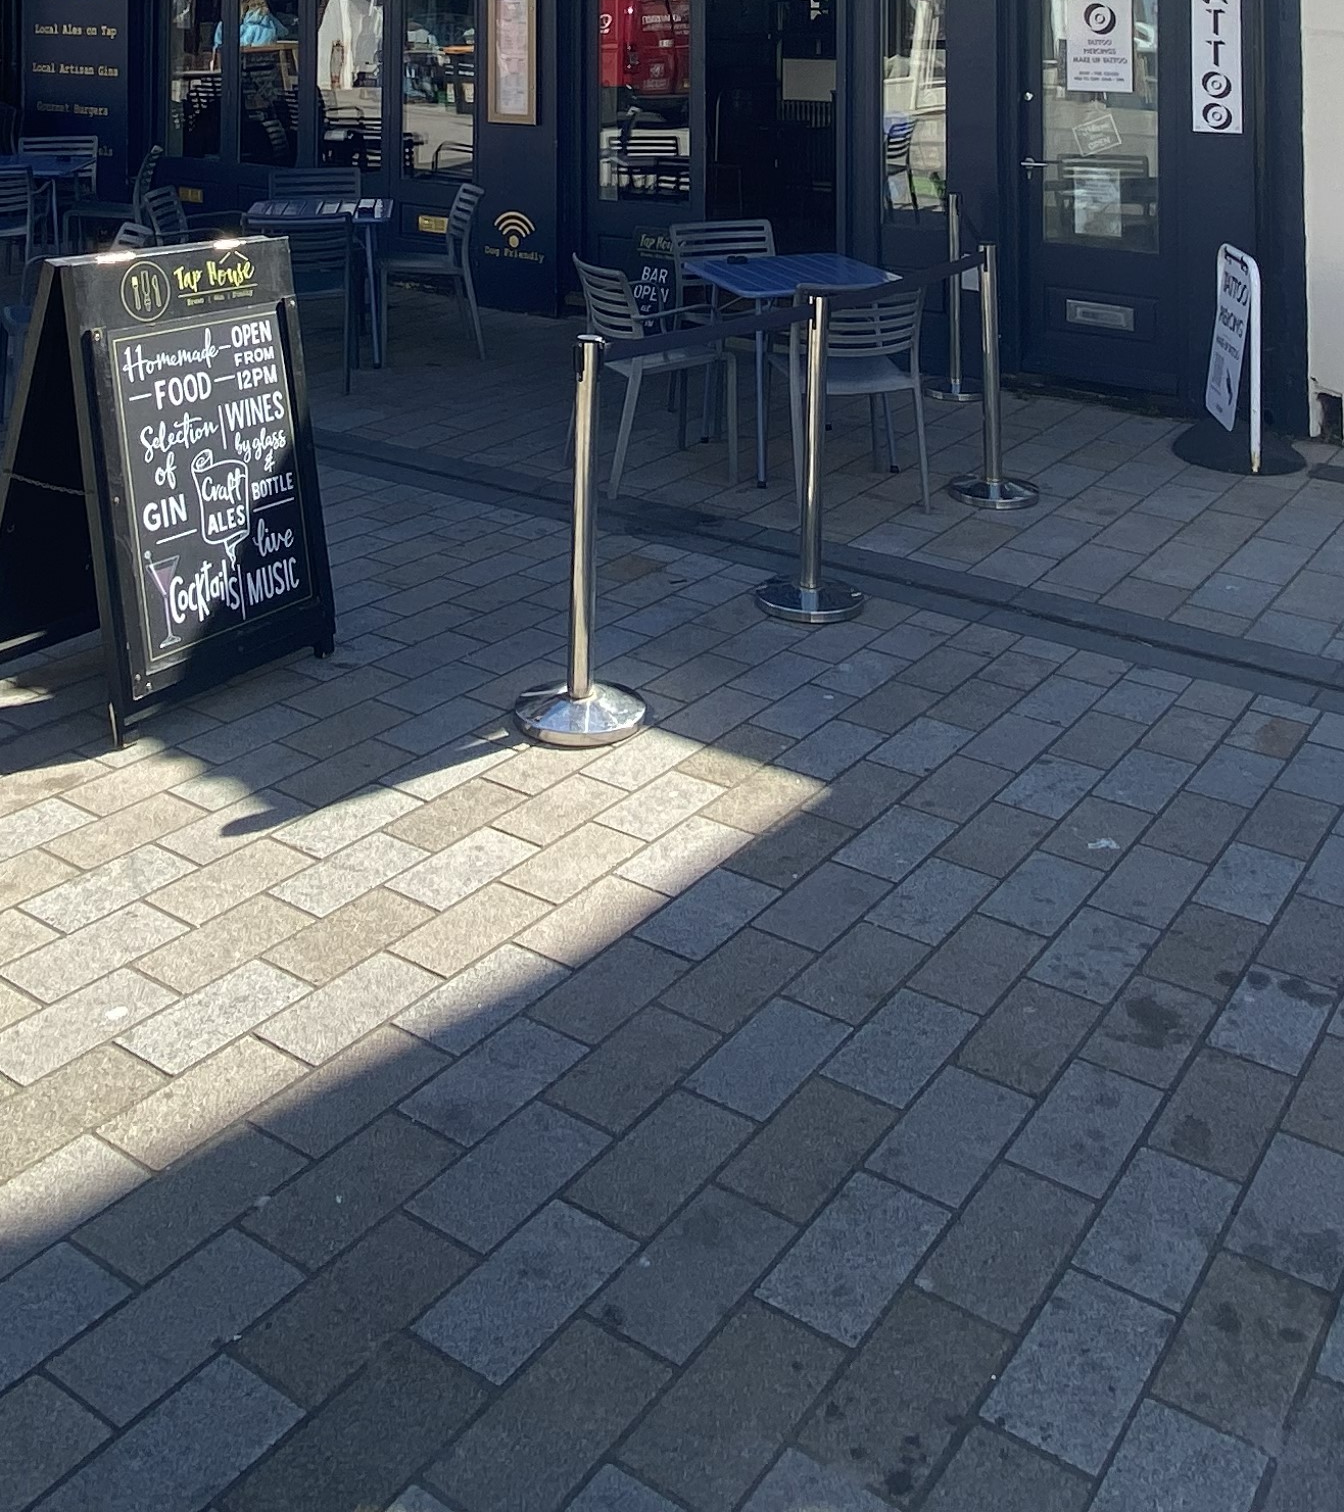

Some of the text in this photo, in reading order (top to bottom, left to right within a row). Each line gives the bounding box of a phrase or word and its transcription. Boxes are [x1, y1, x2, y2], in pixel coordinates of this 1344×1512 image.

[34, 24, 117, 39] Local Ales on Tap
[32, 63, 118, 77] Local Artisan Gins
[36, 101, 109, 117] Gourmet Burgers
[503, 248, 545, 264] Friendly
[173, 260, 255, 293] Tap House
[641, 266, 668, 284] BAR
[231, 319, 272, 348] OPEN
[122, 328, 219, 383] Homemade
[234, 345, 274, 368] FROM
[153, 371, 212, 410] FOOD
[236, 364, 277, 390] 12PM
[225, 391, 285, 431] WINES
[140, 412, 219, 464] Selection
[155, 451, 177, 489] of
[202, 468, 246, 504] Craft
[251, 472, 294, 500] BOTTLE
[143, 493, 188, 531] GIN
[208, 504, 246, 535] ALES
[253, 518, 295, 557] live
[246, 556, 299, 606] MUSIC
